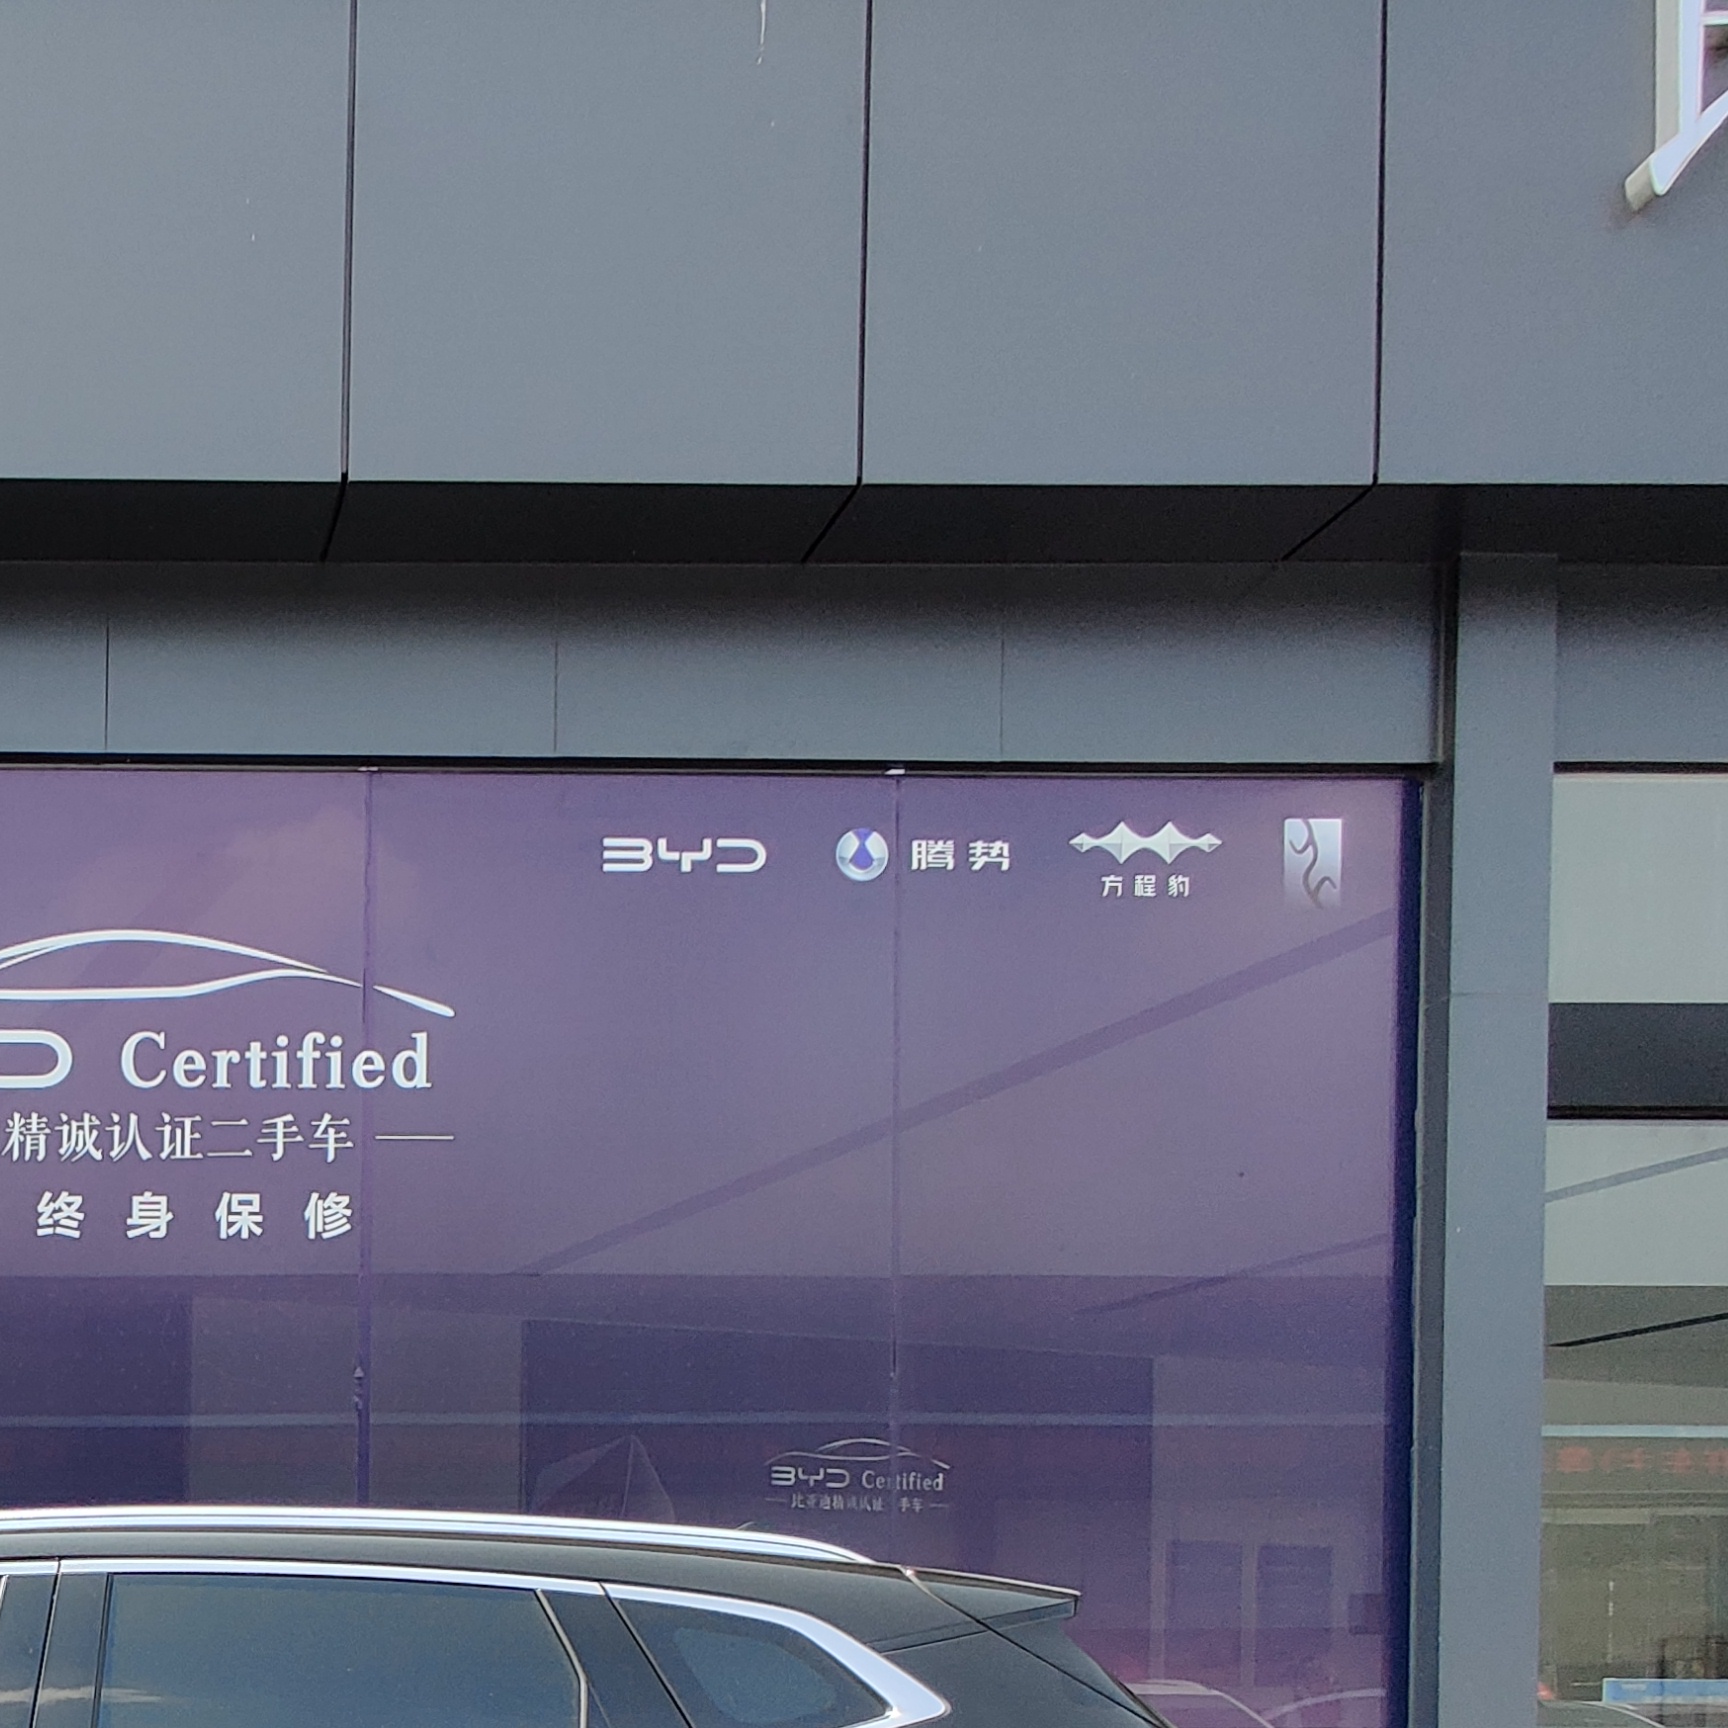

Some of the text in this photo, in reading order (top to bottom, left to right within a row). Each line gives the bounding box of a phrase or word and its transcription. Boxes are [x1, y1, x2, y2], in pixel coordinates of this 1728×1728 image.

[602, 836, 768, 873] BYD
[911, 838, 1011, 872] 腾势
[1100, 873, 1192, 899] 方程豹
[120, 1030, 432, 1090] Certified
[771, 1465, 851, 1489] BYD
